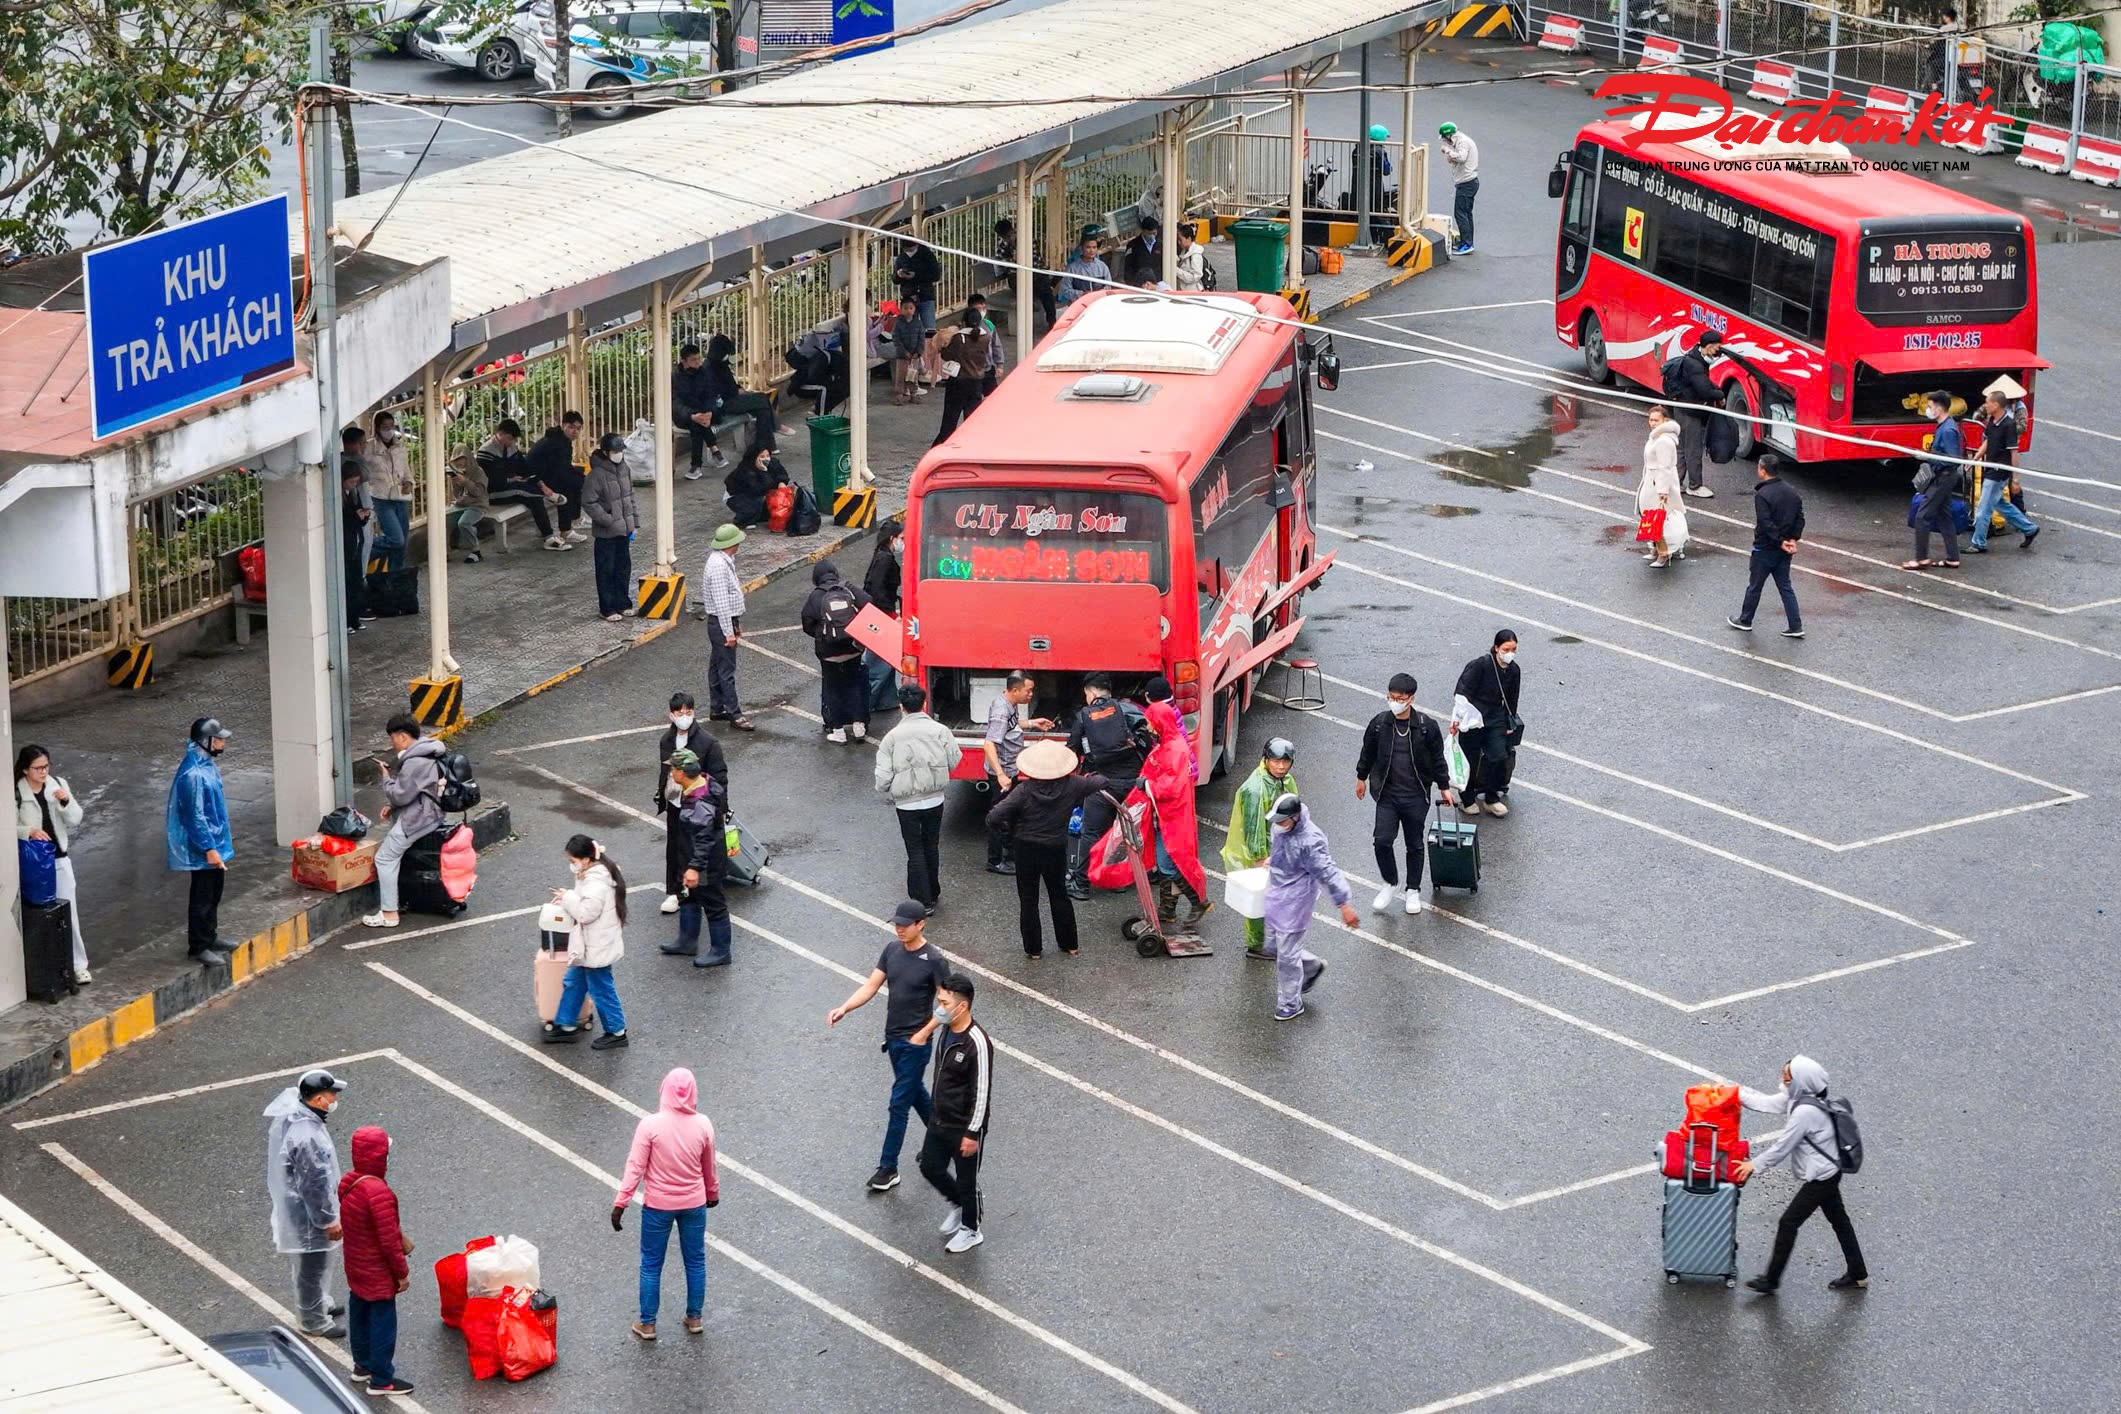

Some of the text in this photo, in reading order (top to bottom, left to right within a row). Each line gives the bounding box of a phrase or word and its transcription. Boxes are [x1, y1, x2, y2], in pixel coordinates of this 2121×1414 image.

[1869, 246, 1882, 263] P
[1894, 240, 1992, 261] HÀ TRUNG
[163, 243, 226, 306] KHU
[1908, 263, 1919, 282] HÀ
[1982, 261, 2000, 280] GIÁP
[1911, 284, 1984, 295] 0913.108.630
[1926, 315, 1962, 324] SAMCO
[108, 292, 282, 392] TRẢ KHÁCH
[1903, 331, 1982, 350] 18B-002.35
[955, 504, 1127, 536] C.Ty Ngân Sơn
[937, 557, 972, 579] Cty
